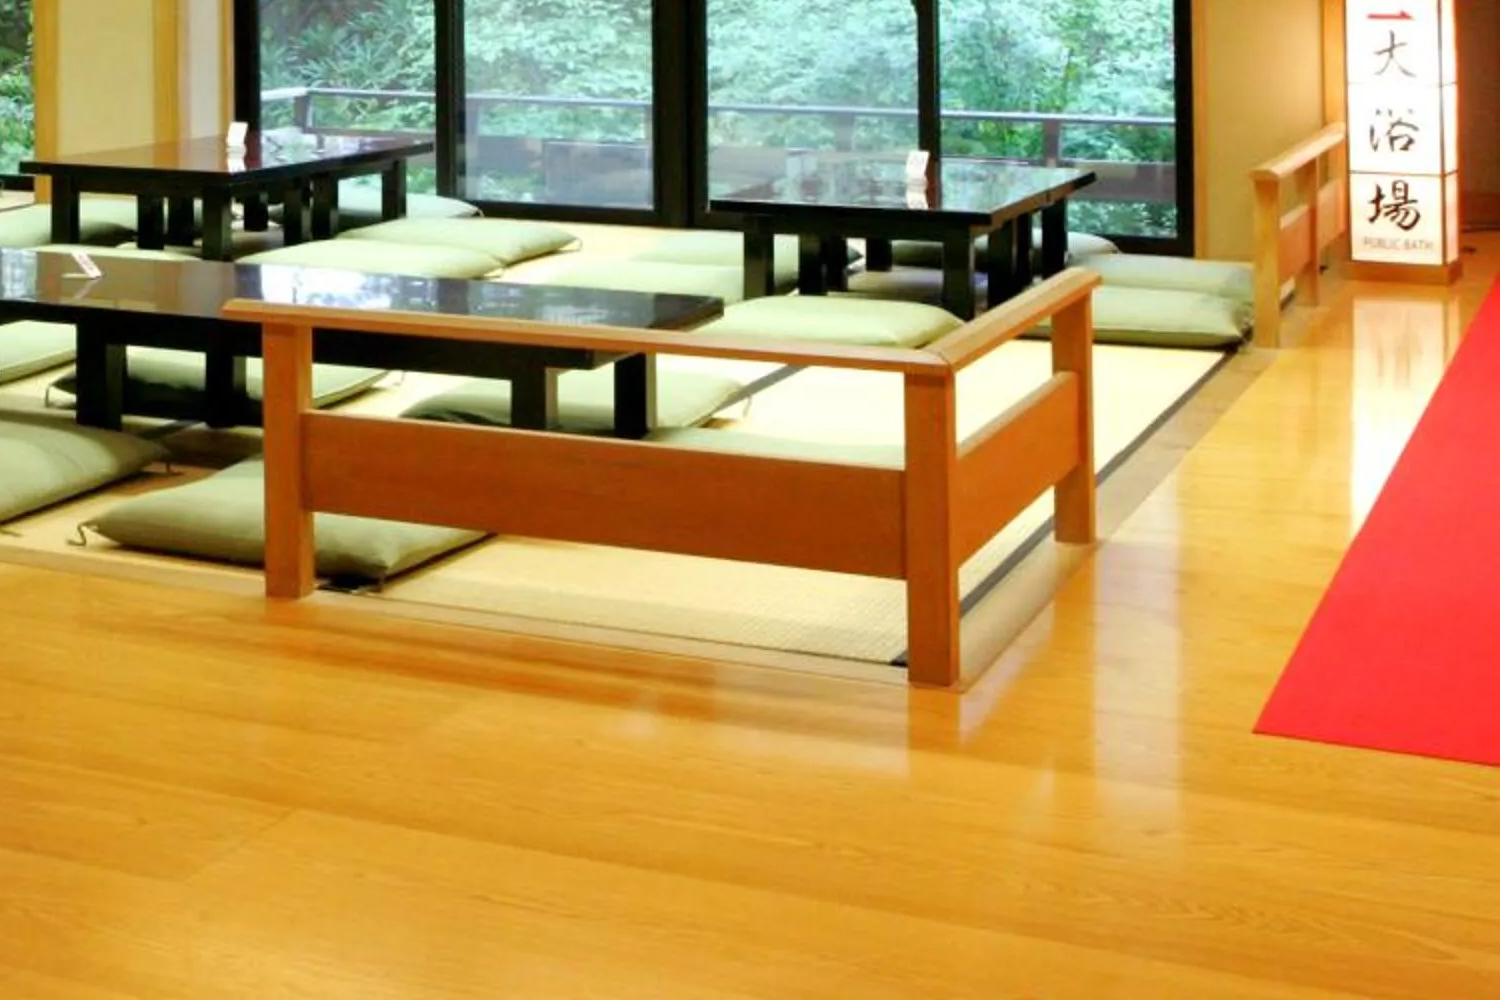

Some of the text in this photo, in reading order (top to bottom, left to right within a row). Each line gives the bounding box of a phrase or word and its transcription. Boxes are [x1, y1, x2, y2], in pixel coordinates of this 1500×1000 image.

[1367, 30, 1421, 231] 大浴場
[1364, 236, 1434, 252] PUBLIC BATH
